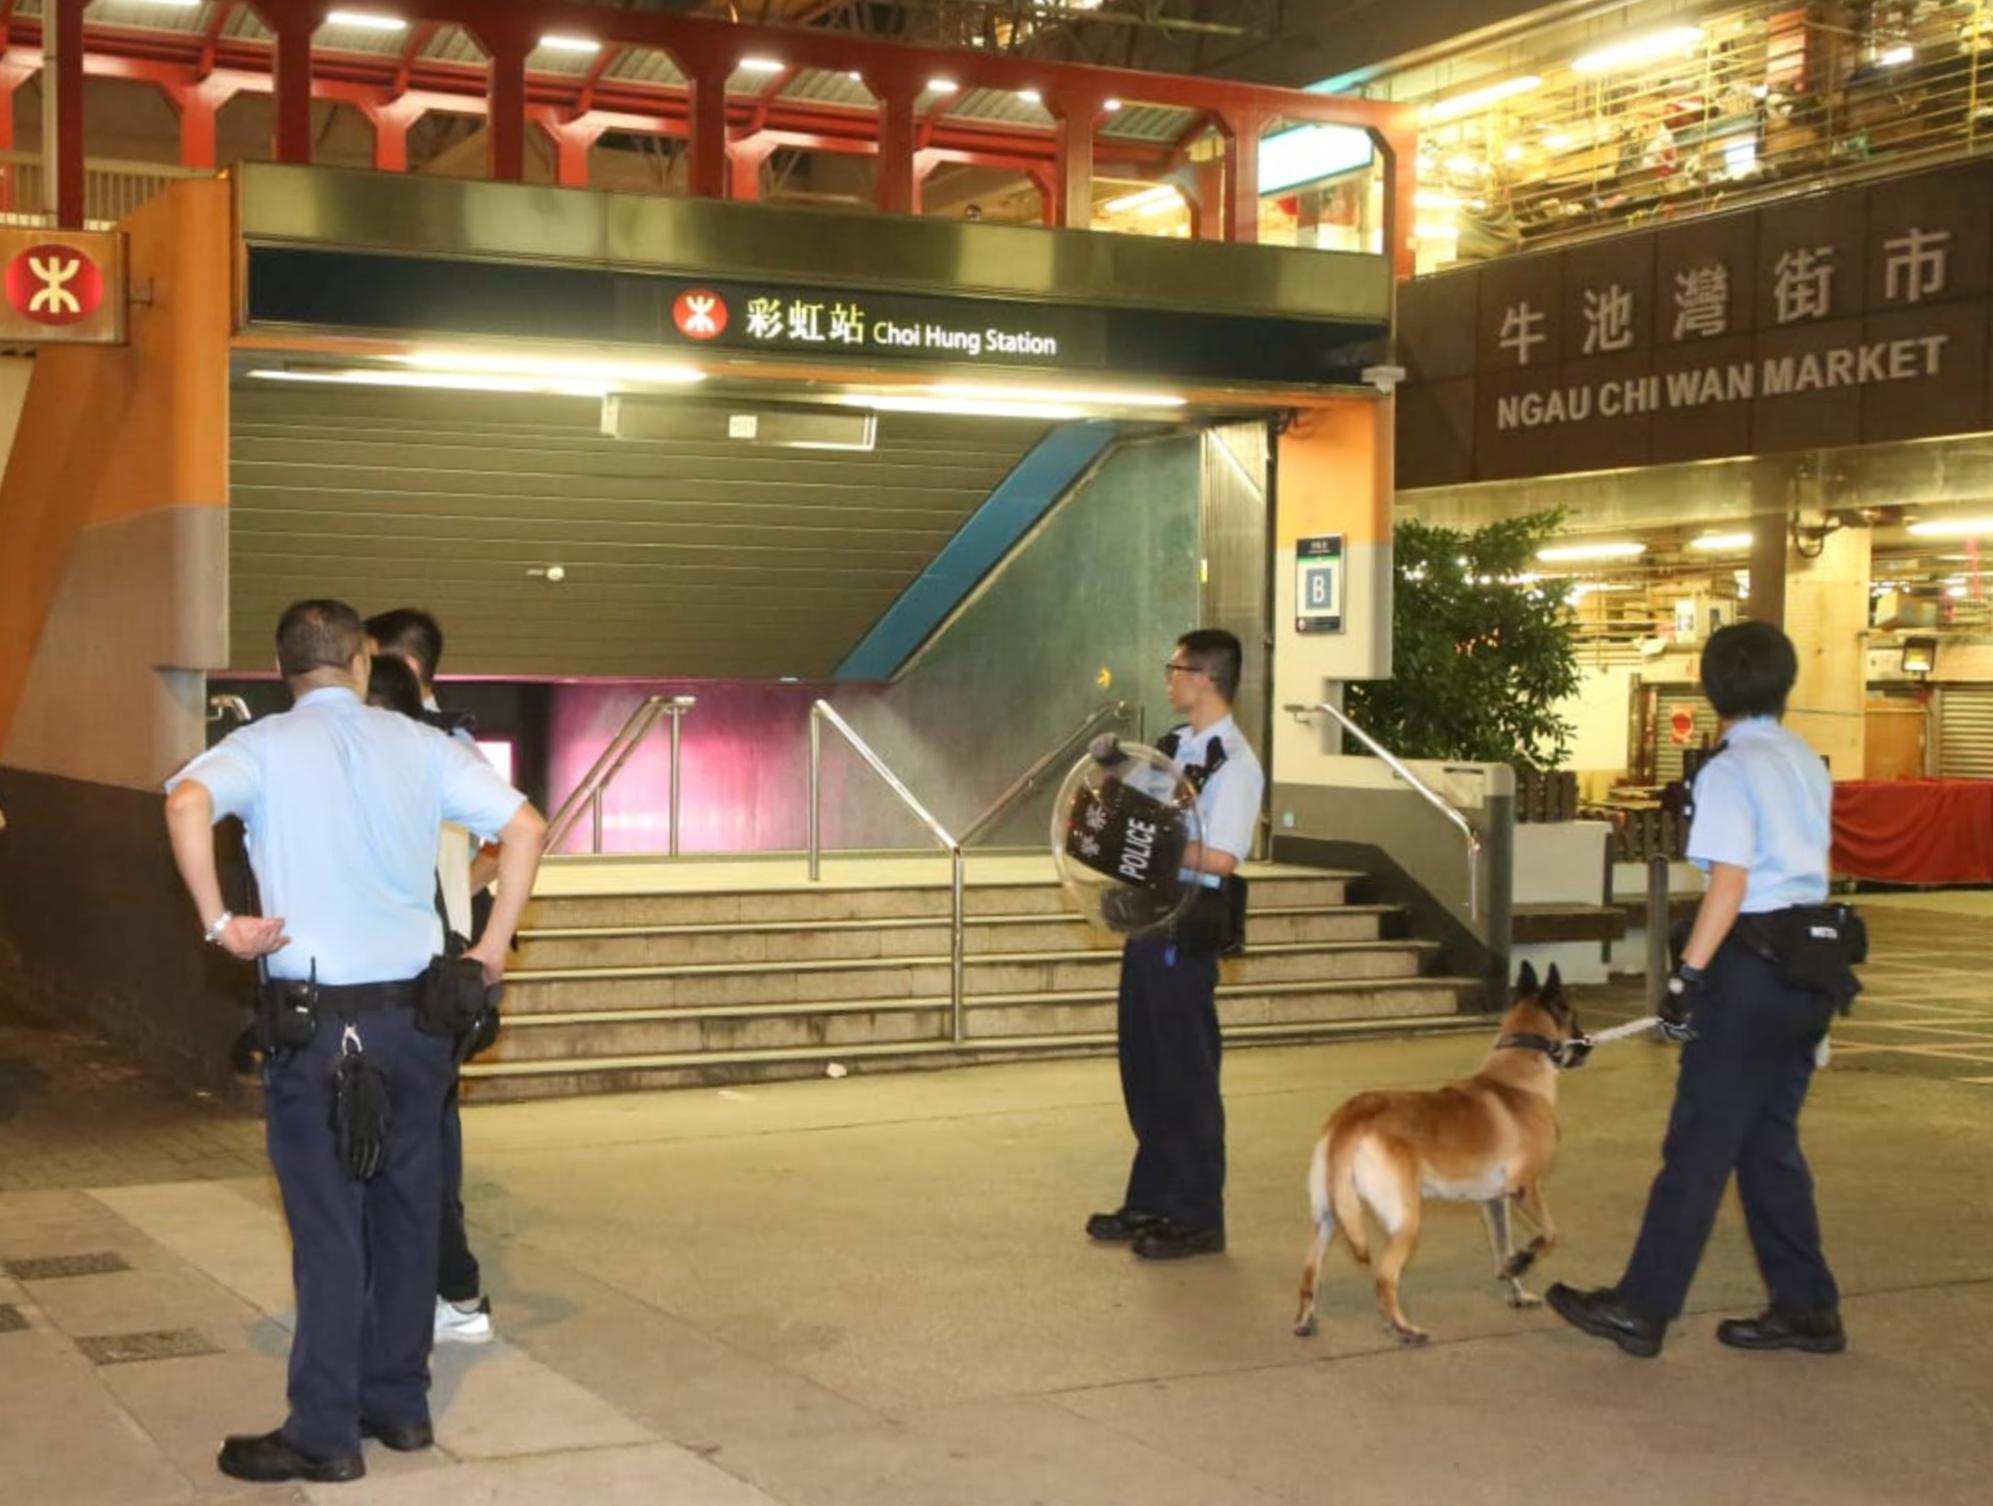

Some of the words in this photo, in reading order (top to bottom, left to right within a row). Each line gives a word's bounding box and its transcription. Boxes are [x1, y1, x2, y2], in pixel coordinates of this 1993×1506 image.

[746, 297, 865, 344] 彩虹站
[1499, 228, 1951, 365] 牛池灣街市
[874, 321, 921, 347] Choi
[925, 325, 981, 356] Hung
[986, 328, 1057, 355] Station
[1497, 385, 1591, 430] NGAU
[1599, 376, 1659, 416] CHI
[1667, 363, 1754, 407] WAN
[1762, 335, 1949, 396] MARKET
[1312, 574, 1325, 604] B
[1119, 817, 1158, 880] POLICE
